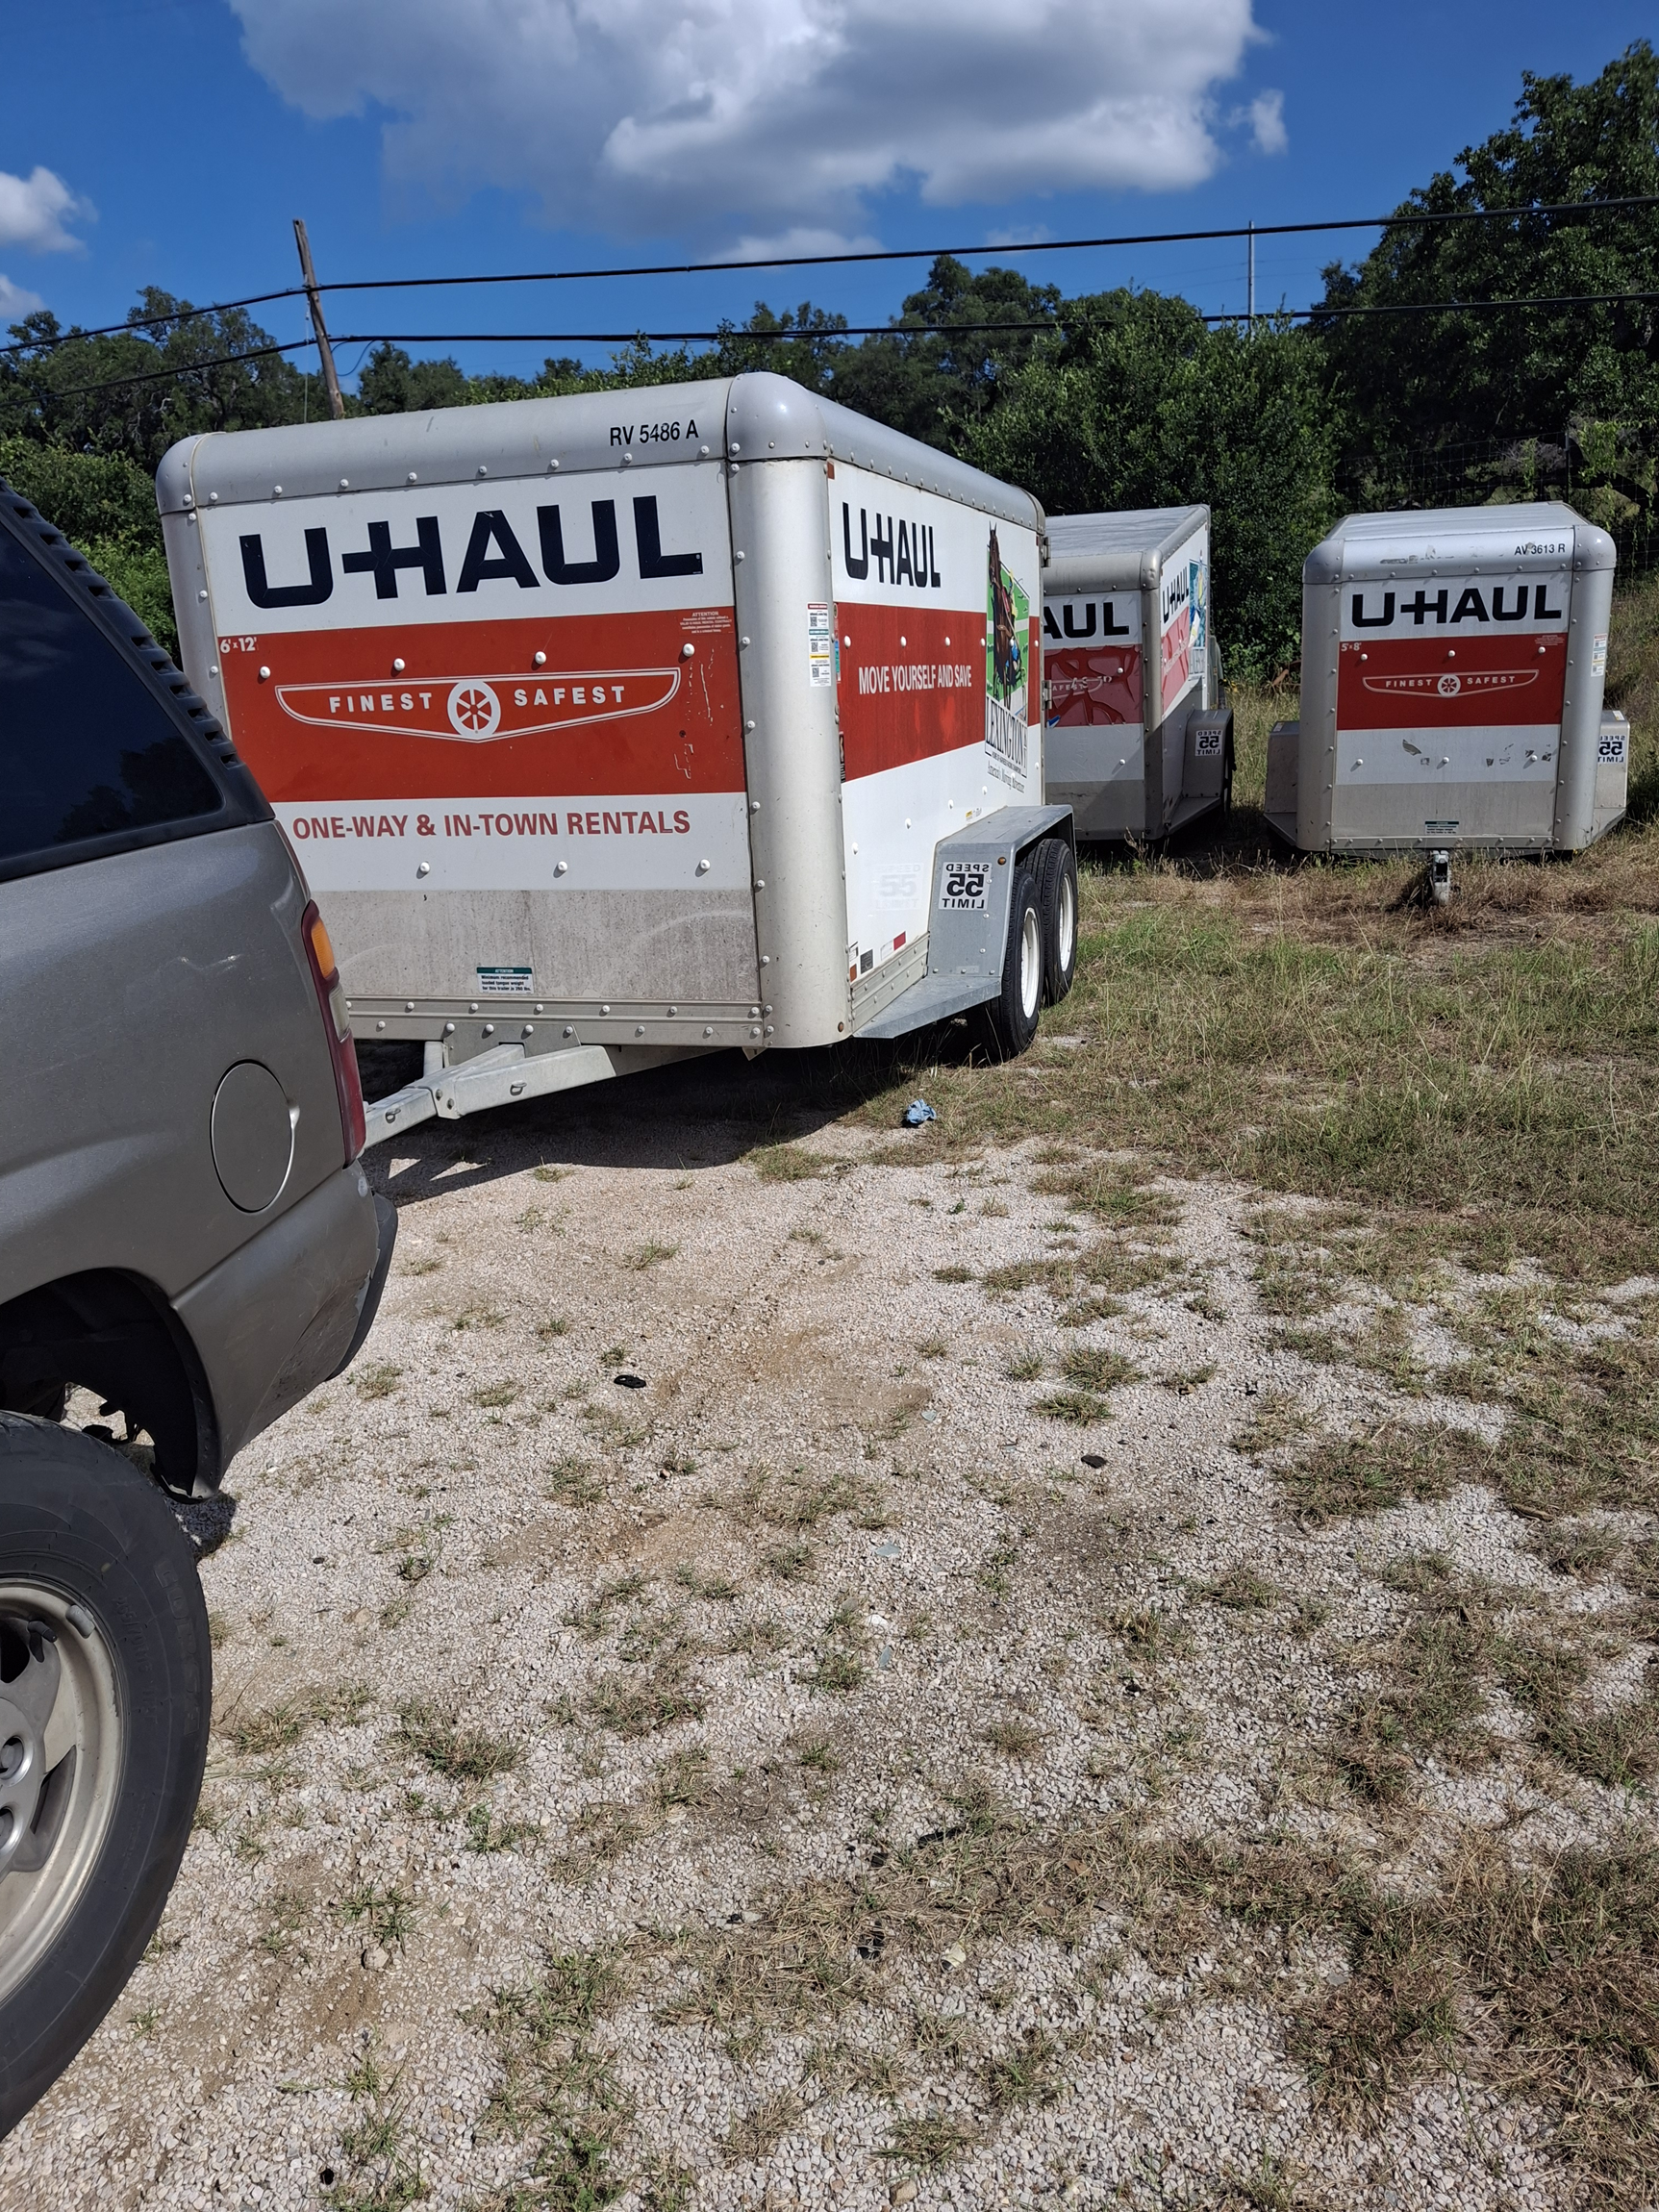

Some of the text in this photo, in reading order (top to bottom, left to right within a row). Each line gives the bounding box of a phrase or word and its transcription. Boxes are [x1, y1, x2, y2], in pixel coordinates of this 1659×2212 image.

[610, 418, 699, 446] RV 5486 A
[239, 495, 703, 609] U-HAUL
[842, 501, 941, 588] U-HAUL
[1514, 542, 1566, 556] AV 3613 R
[1352, 585, 1562, 628] U-HAUL
[858, 666, 890, 694] MOVE
[892, 665, 936, 691] YOURSELF
[938, 665, 953, 688] AND
[954, 665, 972, 688] SAVE
[1386, 676, 1516, 688] FINEST SAFEST
[329, 686, 625, 713] FINEST SAFEST
[293, 810, 691, 840] ONE-WAY & IN-TOWN RENTALS
